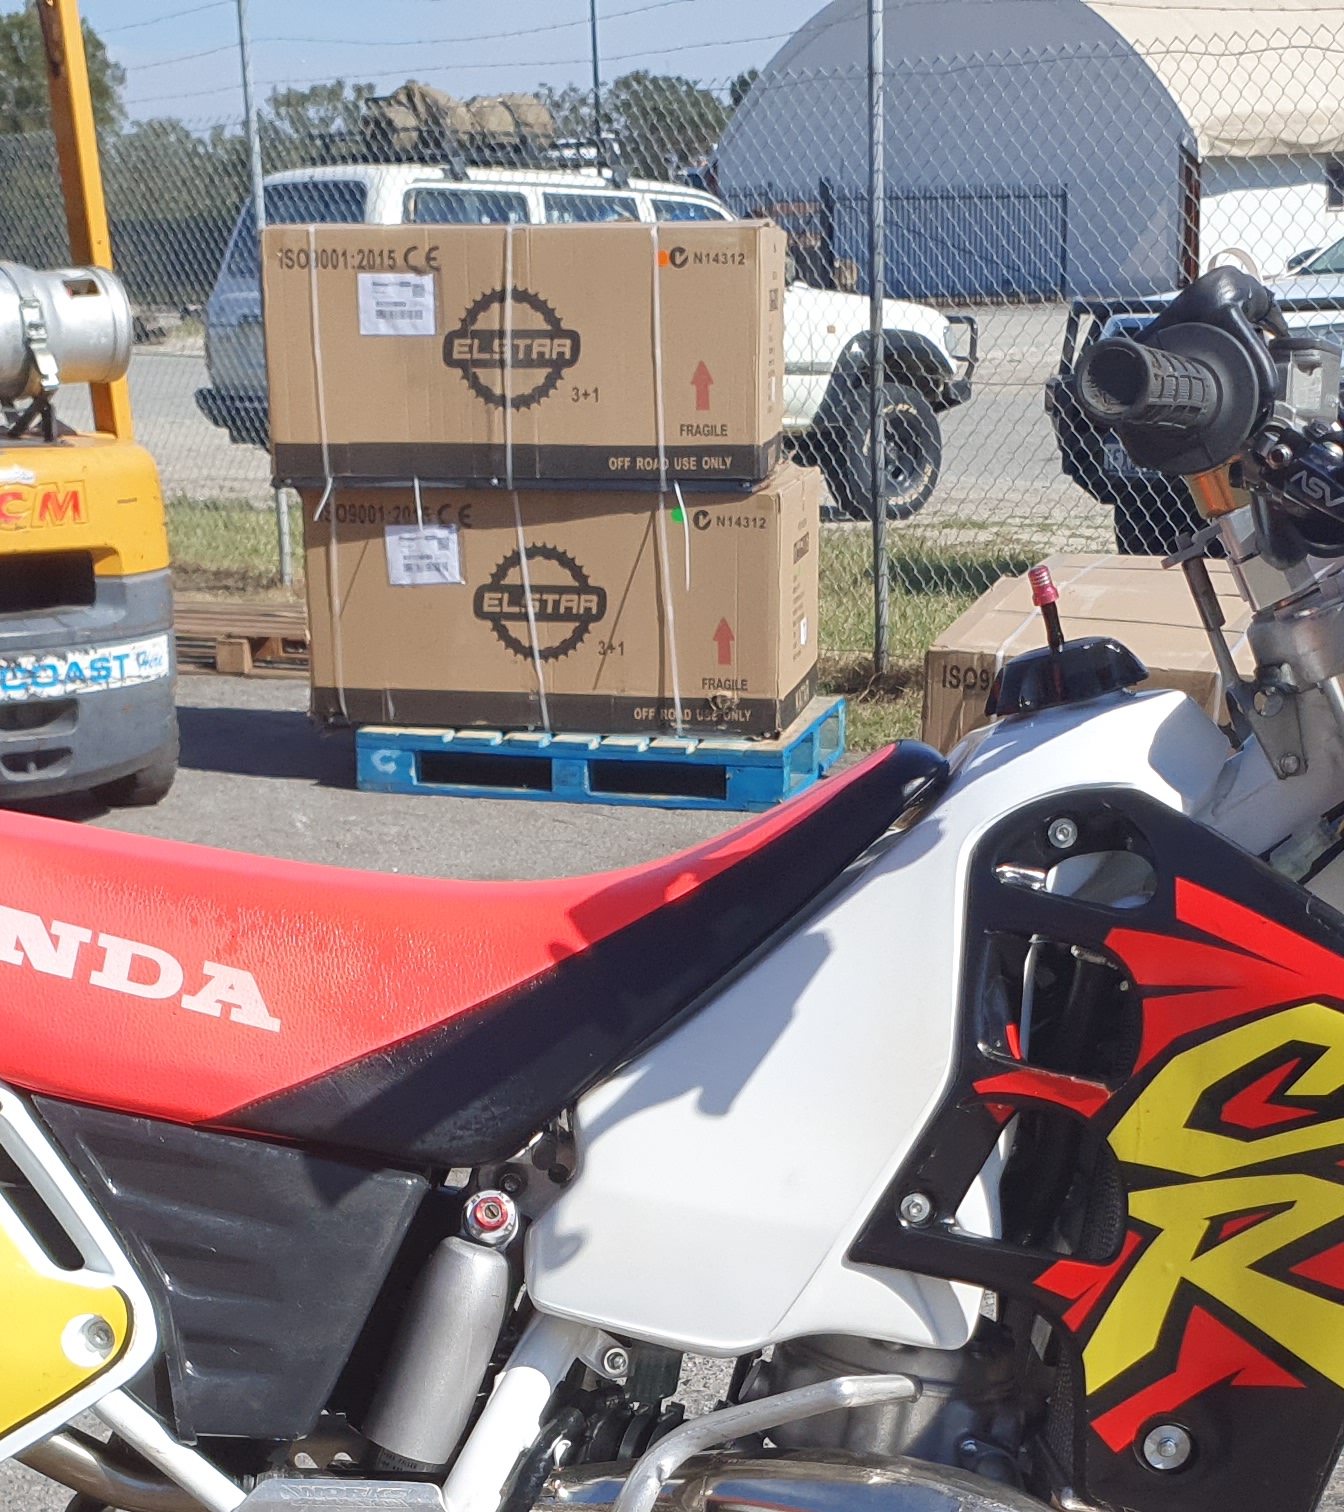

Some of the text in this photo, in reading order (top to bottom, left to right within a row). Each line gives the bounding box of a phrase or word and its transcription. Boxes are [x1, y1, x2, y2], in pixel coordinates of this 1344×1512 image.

[693, 252, 746, 266] N14312
[571, 387, 600, 403] 3+1
[679, 423, 729, 437] FRAGILE
[609, 457, 631, 471] OFF
[674, 457, 698, 471] USE
[702, 456, 733, 470] ONLY
[716, 517, 768, 530] N14312
[598, 640, 625, 656] 3+1
[0, 652, 131, 692] COAST
[942, 664, 995, 690] ISO9
[701, 677, 749, 691] FRAGILE
[634, 707, 655, 720] OFF
[660, 708, 692, 721] ROD
[723, 709, 752, 721] ONLY
